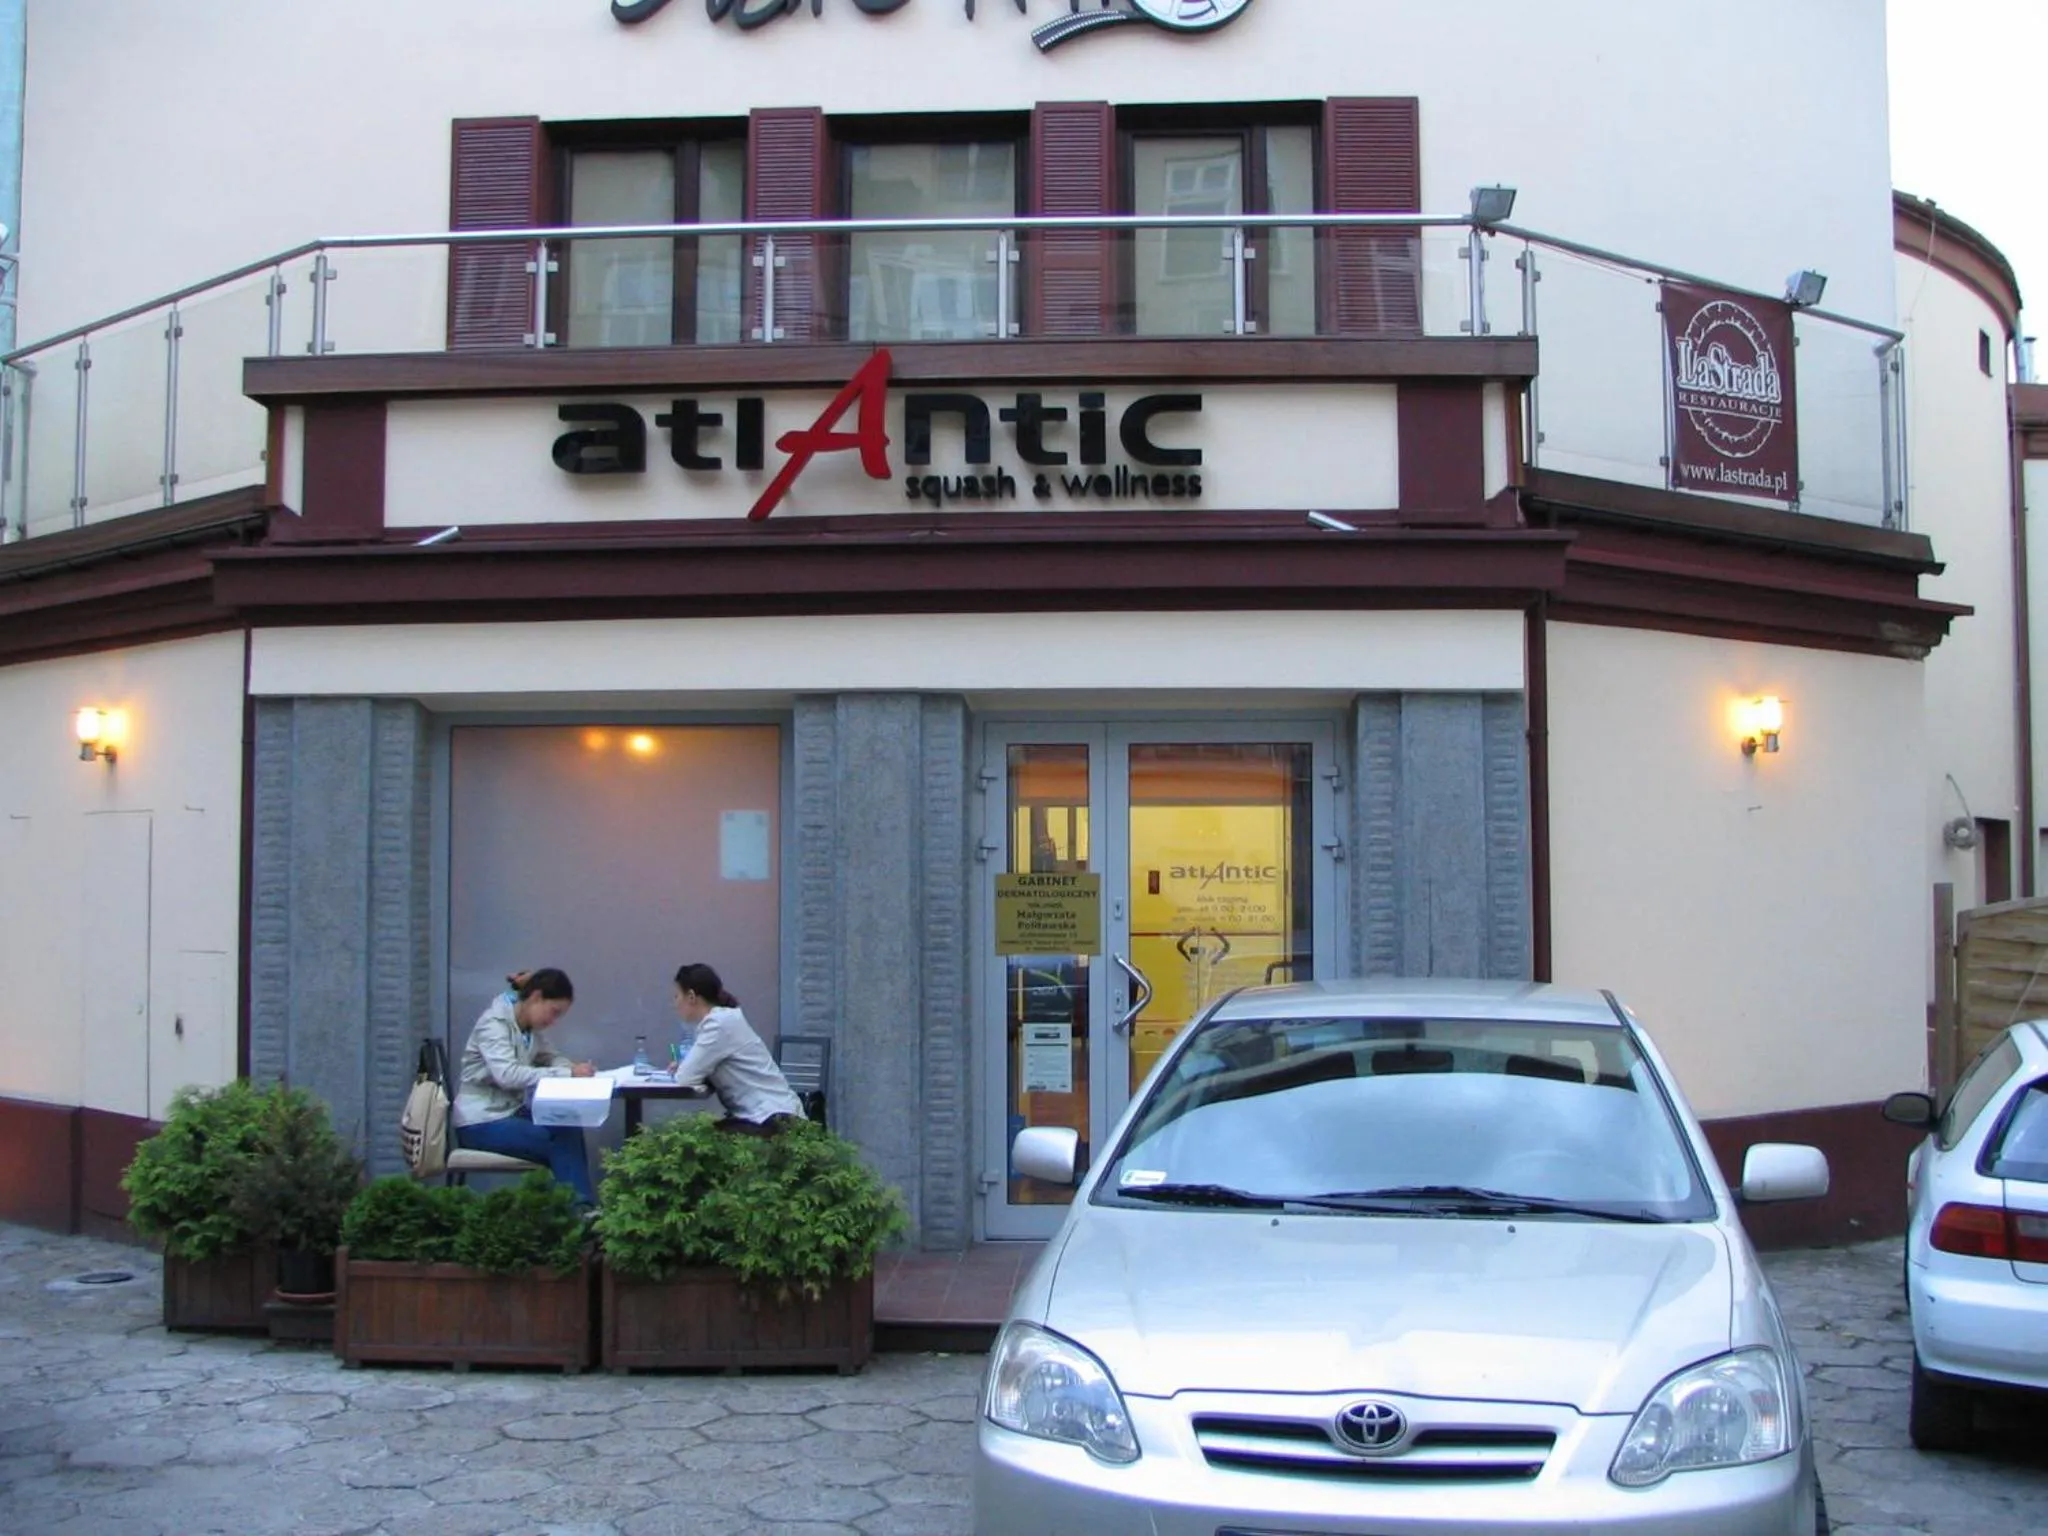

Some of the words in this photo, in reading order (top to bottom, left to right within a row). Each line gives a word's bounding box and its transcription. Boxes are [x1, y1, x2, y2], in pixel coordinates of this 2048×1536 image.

[1678, 391, 1783, 418] RESTAURACJE
[905, 465, 1016, 507] squash
[1033, 474, 1051, 498] &
[1061, 465, 1203, 499] wellness
[1680, 462, 1789, 496] www.lastrada.pl
[997, 889, 1098, 898] DERMATOLOGICZNY
[1017, 876, 1077, 886] GABINET
